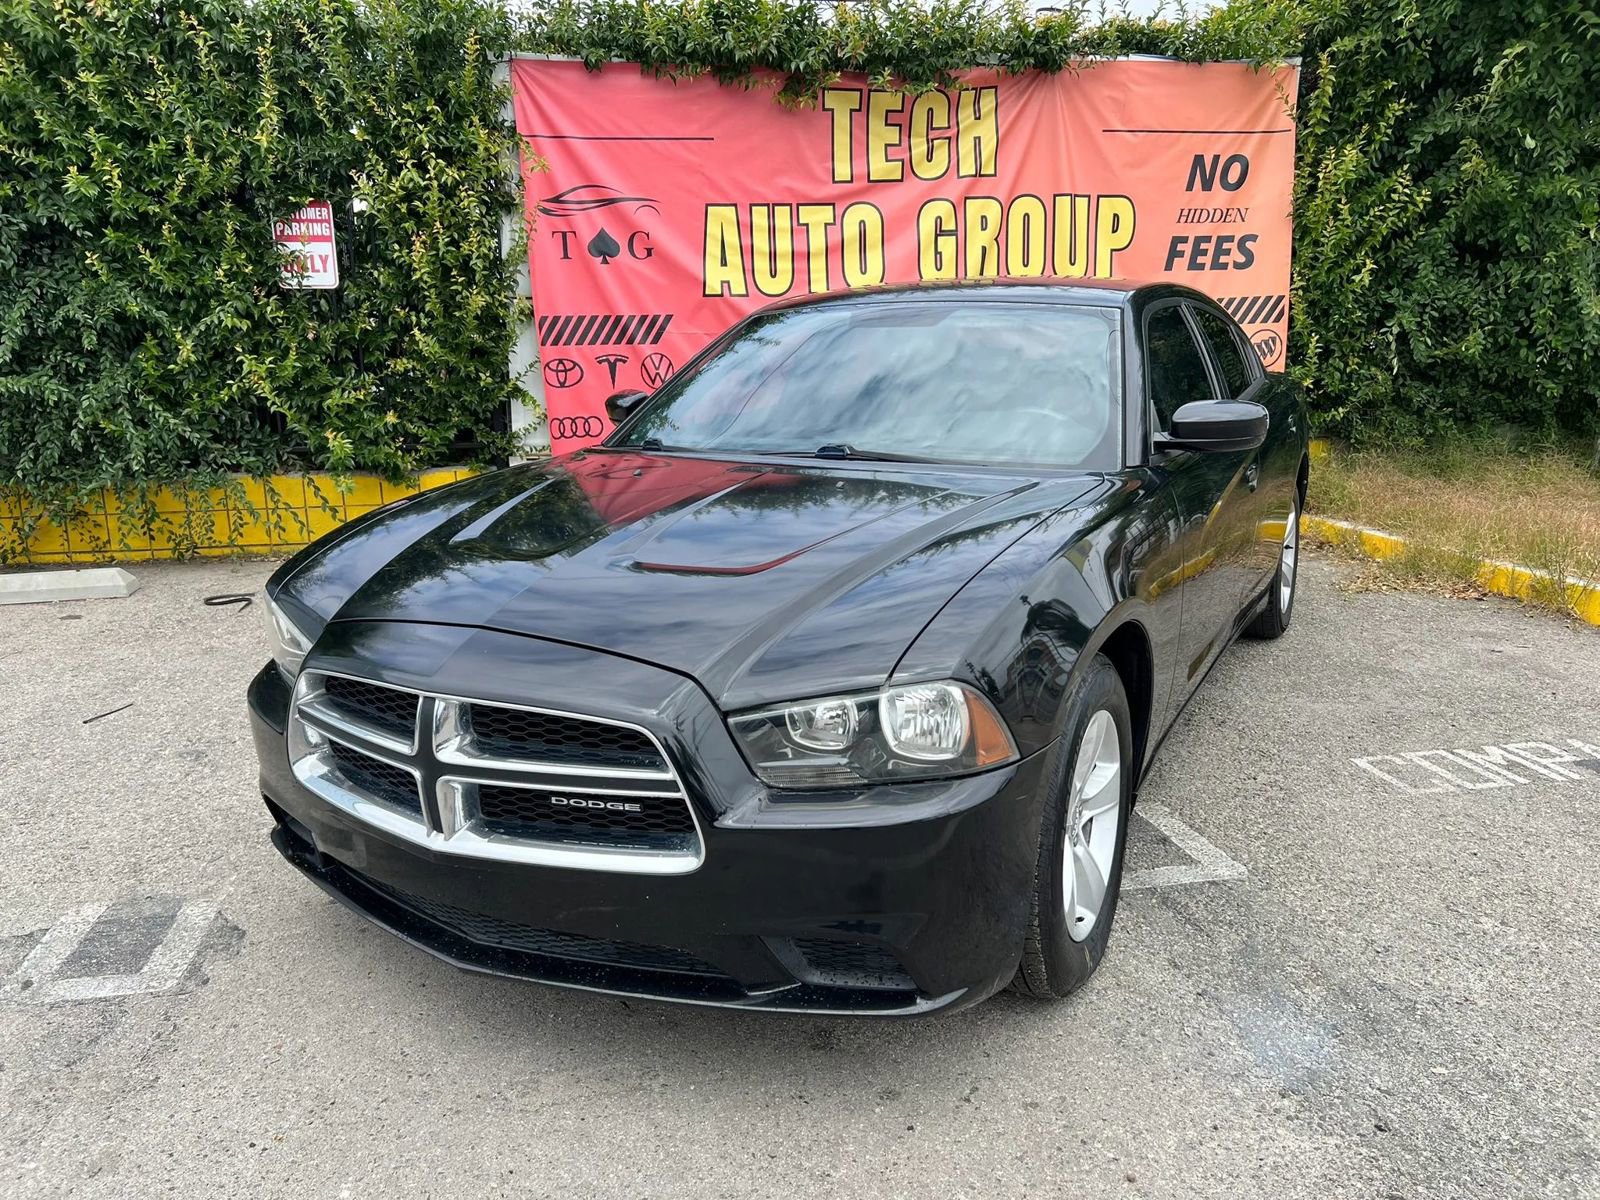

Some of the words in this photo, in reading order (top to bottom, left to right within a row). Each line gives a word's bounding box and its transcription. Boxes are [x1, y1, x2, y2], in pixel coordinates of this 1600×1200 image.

[822, 86, 998, 184] TECH
[1185, 153, 1249, 192] NO
[275, 222, 330, 236] PARKING
[1176, 207, 1250, 224] HIDDEN
[551, 230, 577, 260] T
[628, 230, 655, 260] G
[702, 201, 885, 297] AUTO
[917, 193, 1136, 281] GROUP
[1163, 233, 1259, 272] FEES
[551, 796, 642, 812] DODGE
